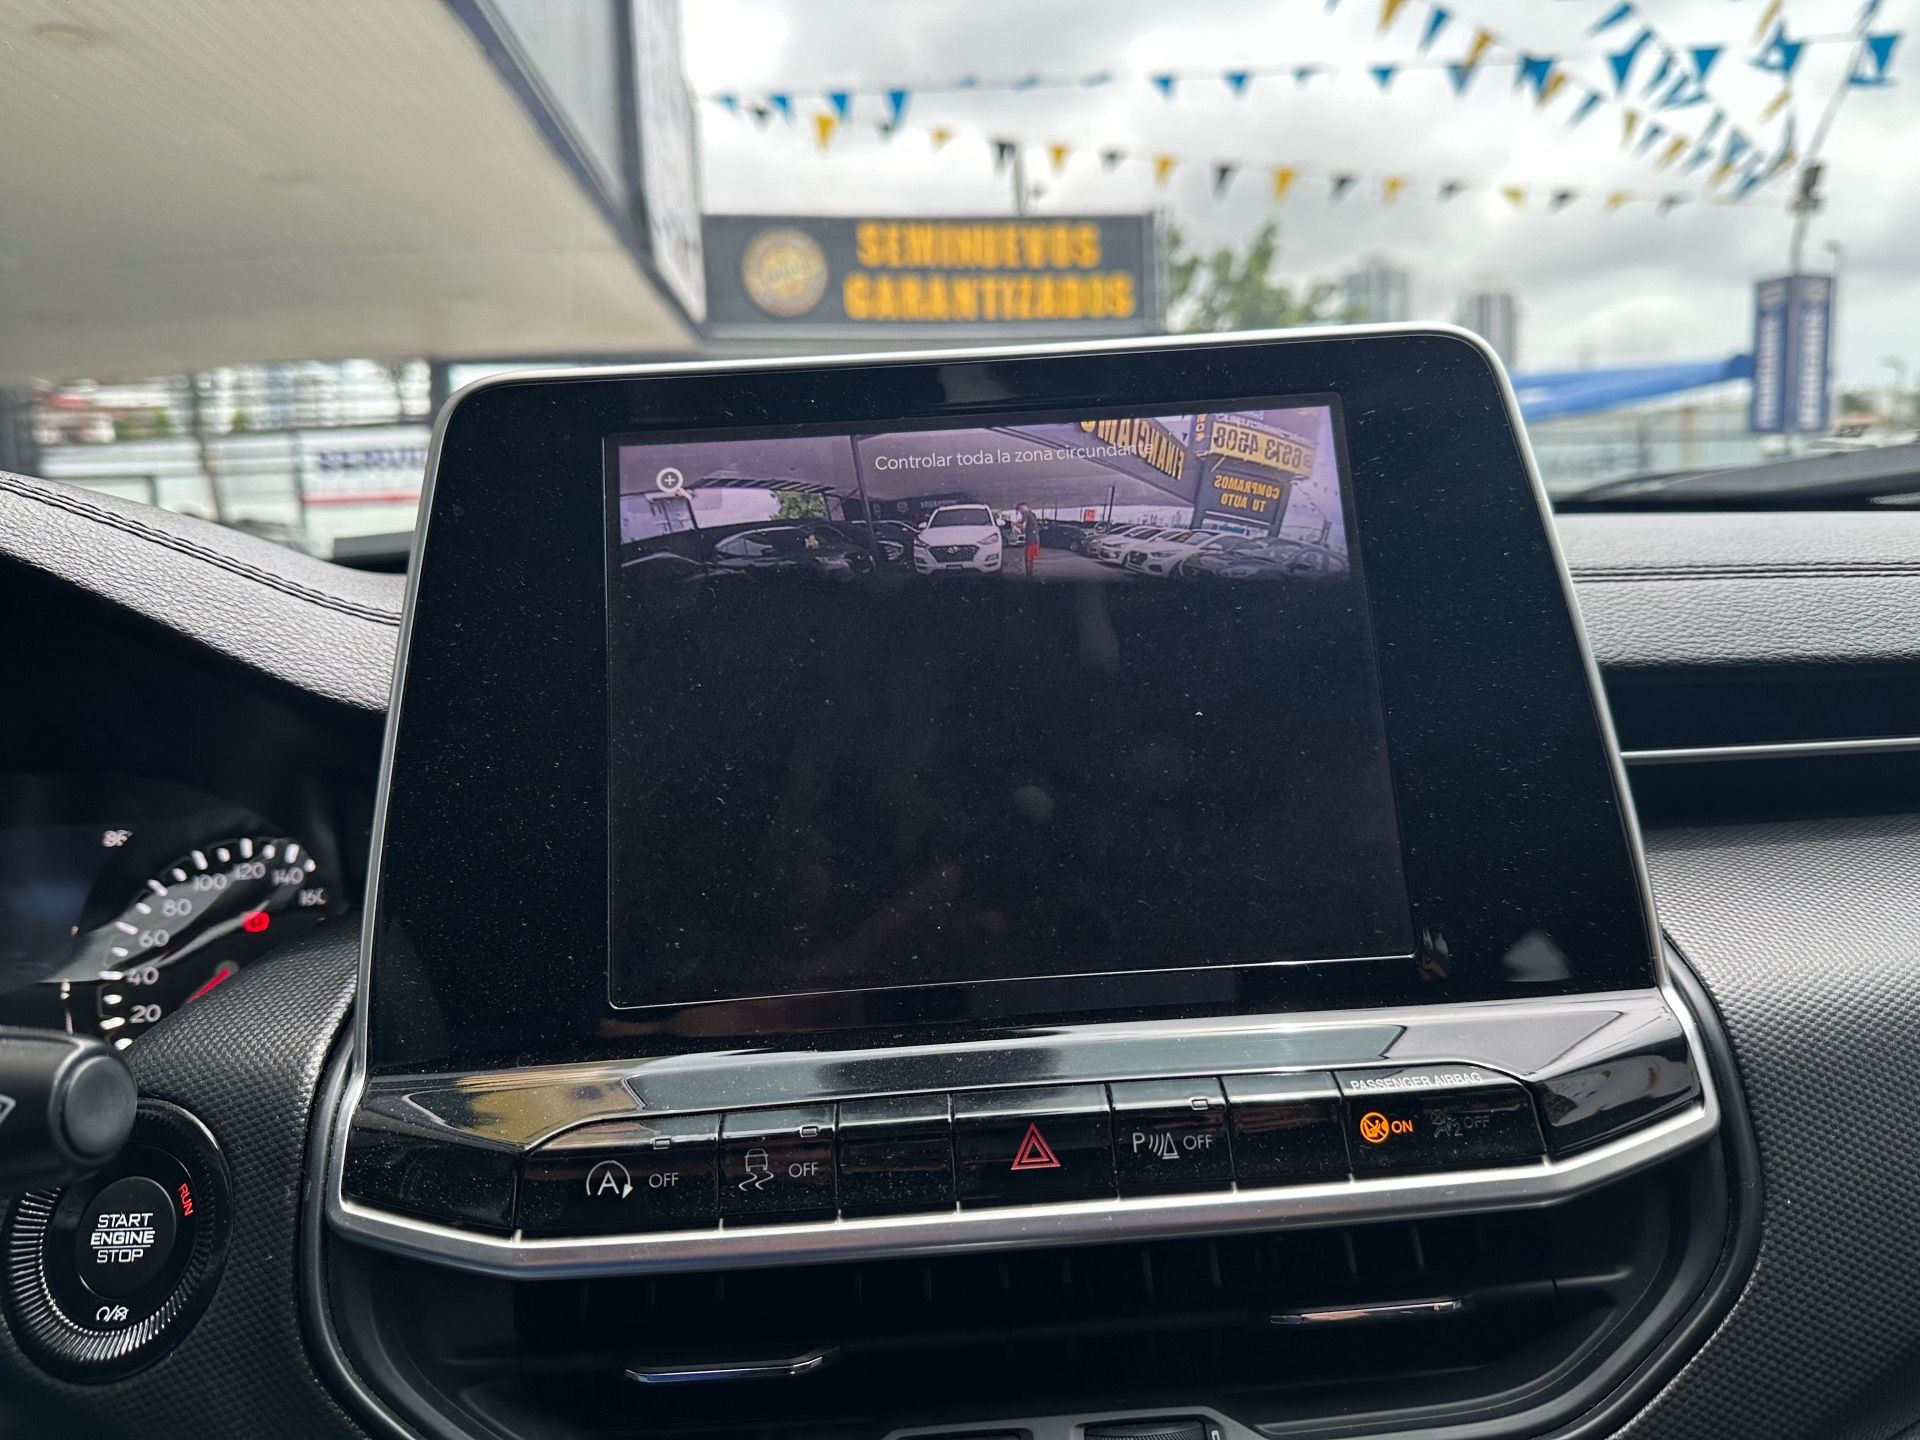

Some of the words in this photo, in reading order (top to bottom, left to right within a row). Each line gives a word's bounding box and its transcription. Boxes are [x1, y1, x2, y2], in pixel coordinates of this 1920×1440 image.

[855, 222, 1100, 269] SEMINUEVOS
[843, 271, 1135, 321] GARANTIZADOS
[874, 453, 953, 471] Controlar
[956, 449, 994, 466] toda
[997, 448, 1011, 464] la
[1014, 447, 1053, 463] zona
[1056, 441, 1154, 460] circundante
[233, 861, 267, 881] 120
[271, 866, 305, 886] 140
[192, 873, 229, 892] 100
[162, 898, 193, 917] 80
[138, 928, 171, 948] 60
[126, 966, 160, 986] 40
[128, 1003, 162, 1023] 20
[1350, 1074, 1433, 1092] PASSENGER
[1435, 1072, 1482, 1087] AIRBAG
[1391, 1119, 1414, 1134] ON
[1463, 1115, 1490, 1129] OFF
[1132, 1132, 1146, 1153] P
[1182, 1134, 1214, 1150] OFF
[648, 1173, 680, 1188] OFF
[788, 1162, 819, 1179] OFF
[178, 1183, 193, 1217] RUN
[97, 1213, 153, 1228] START
[90, 1230, 155, 1246] ENGINE
[96, 1248, 144, 1264] STOP
